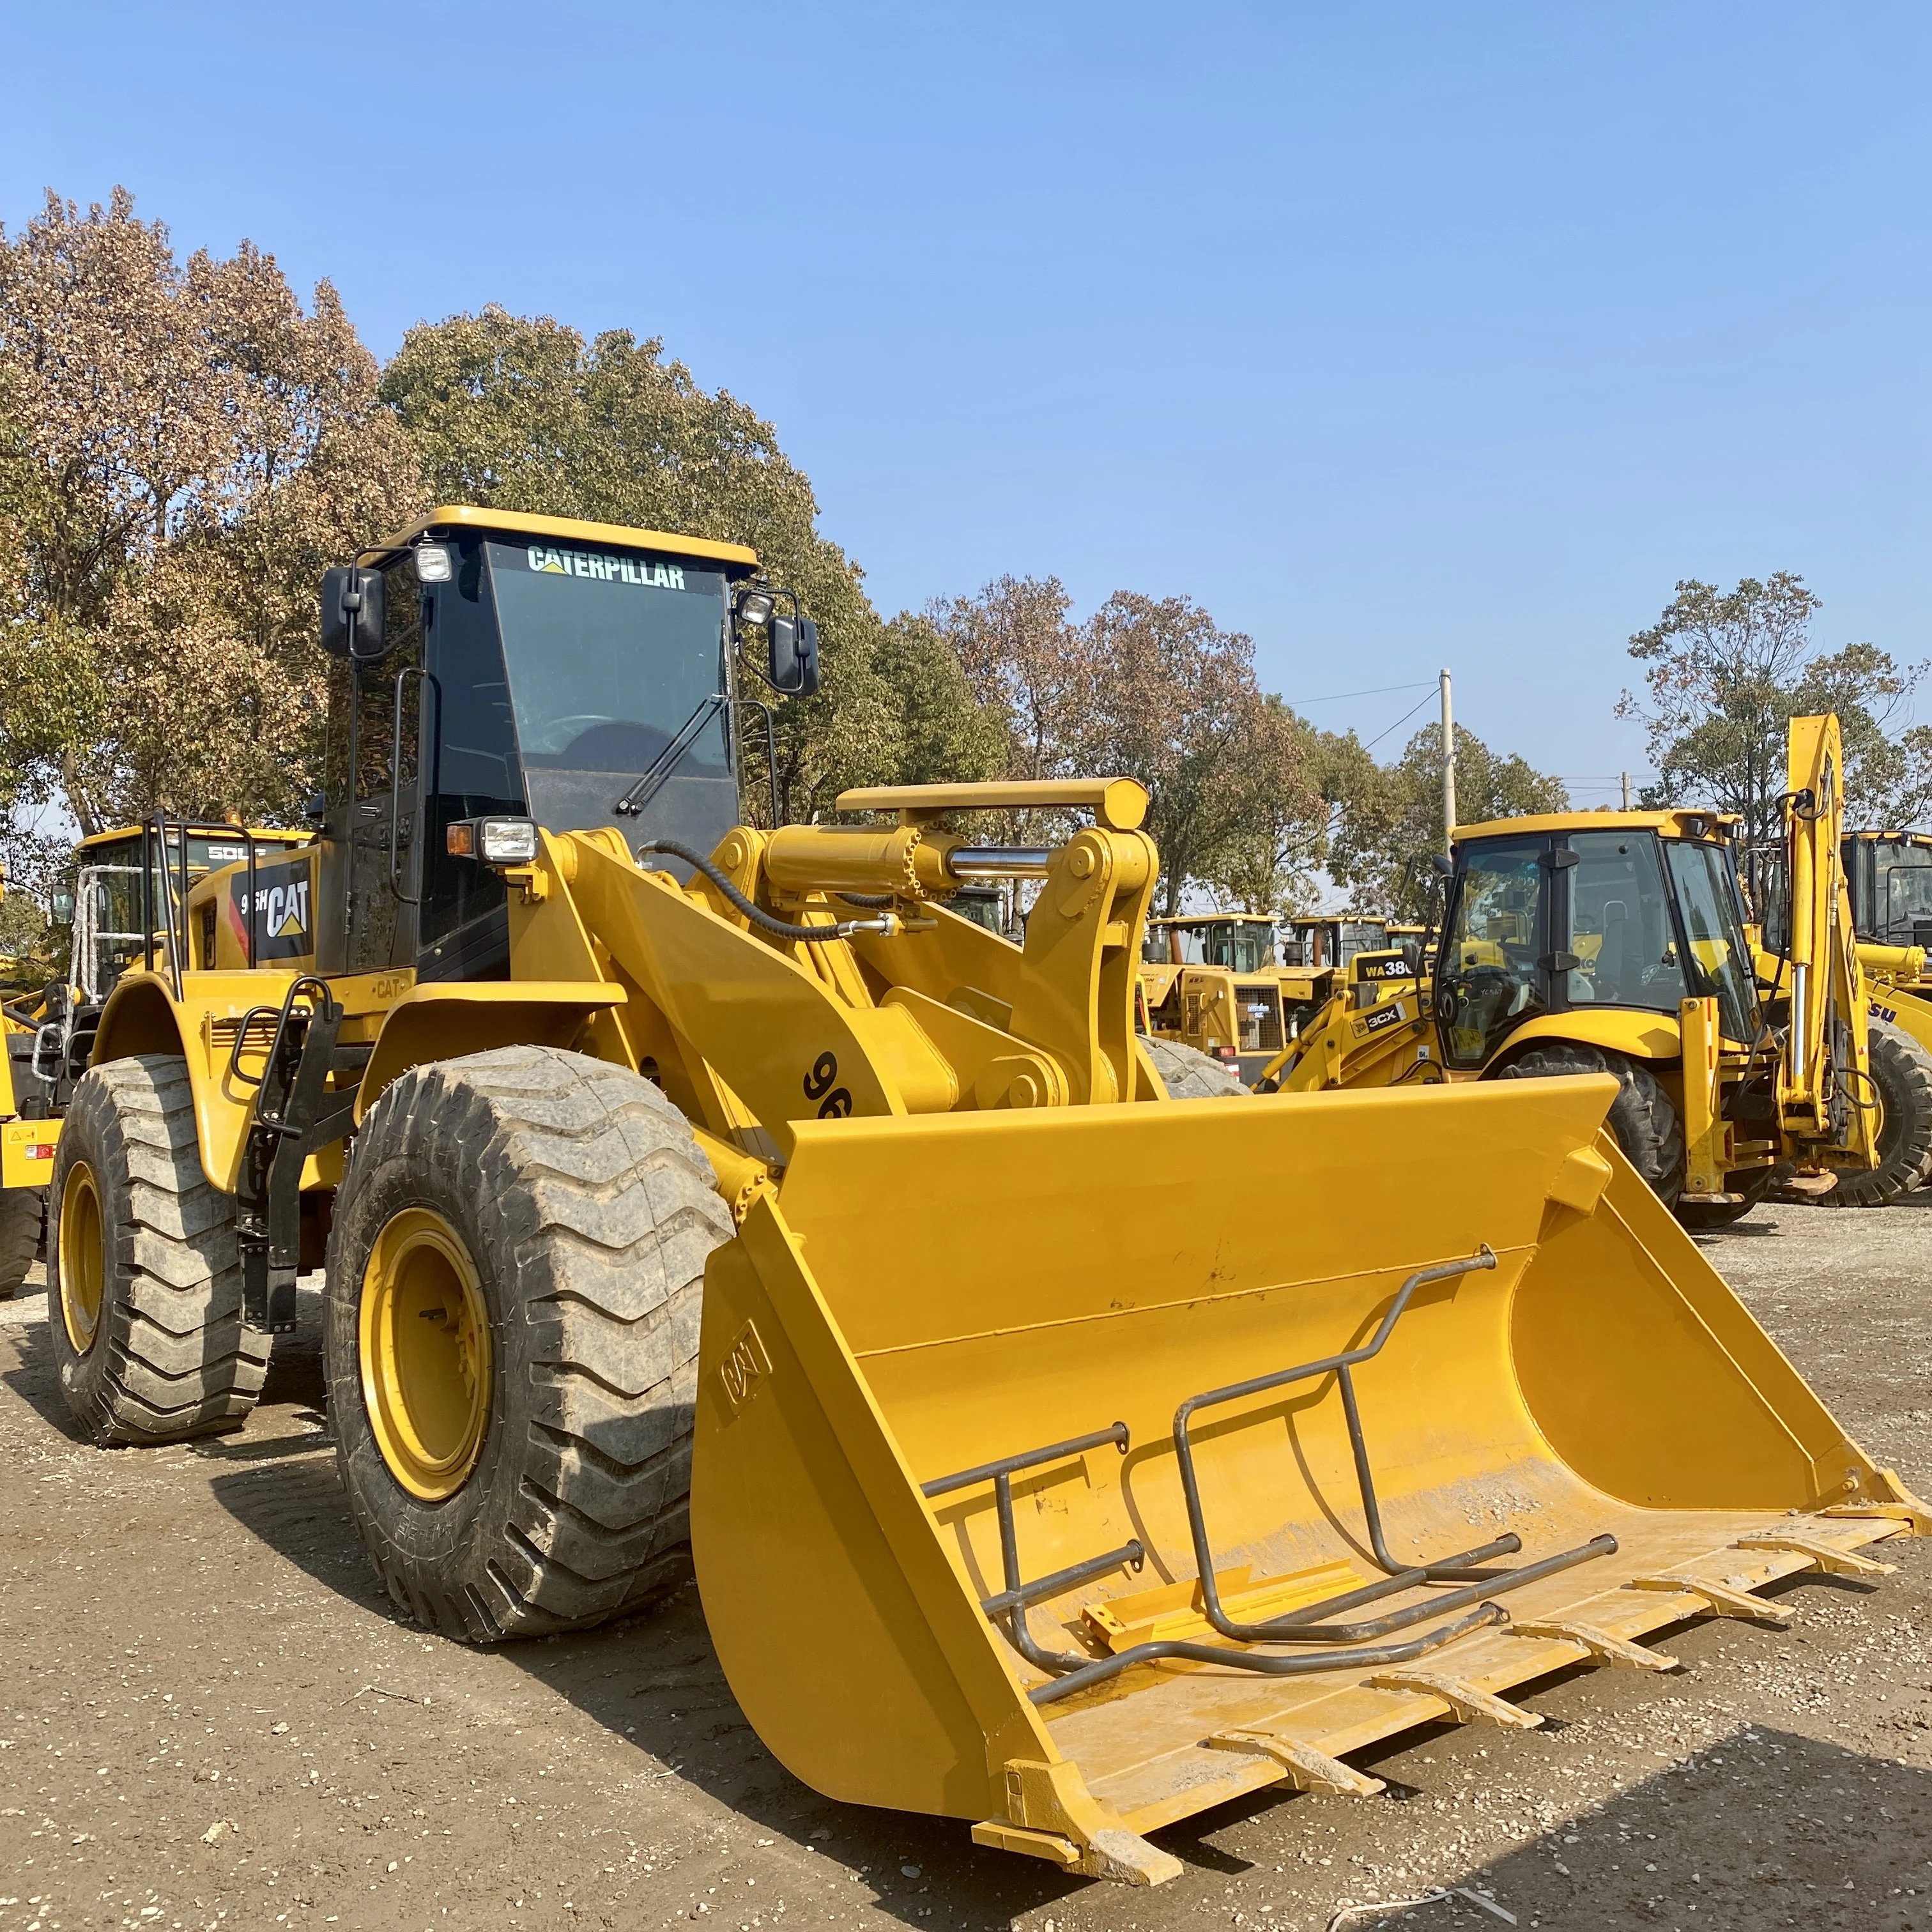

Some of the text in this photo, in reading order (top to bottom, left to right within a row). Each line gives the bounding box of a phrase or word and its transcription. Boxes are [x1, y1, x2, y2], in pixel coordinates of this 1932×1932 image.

[527, 545, 686, 590] CATERPILLAR
[240, 889, 268, 915] 96H
[267, 880, 308, 937] CAT
[377, 978, 399, 998] CAT
[1368, 1009, 1397, 1028] 3CX
[721, 1331, 762, 1405] CAT
